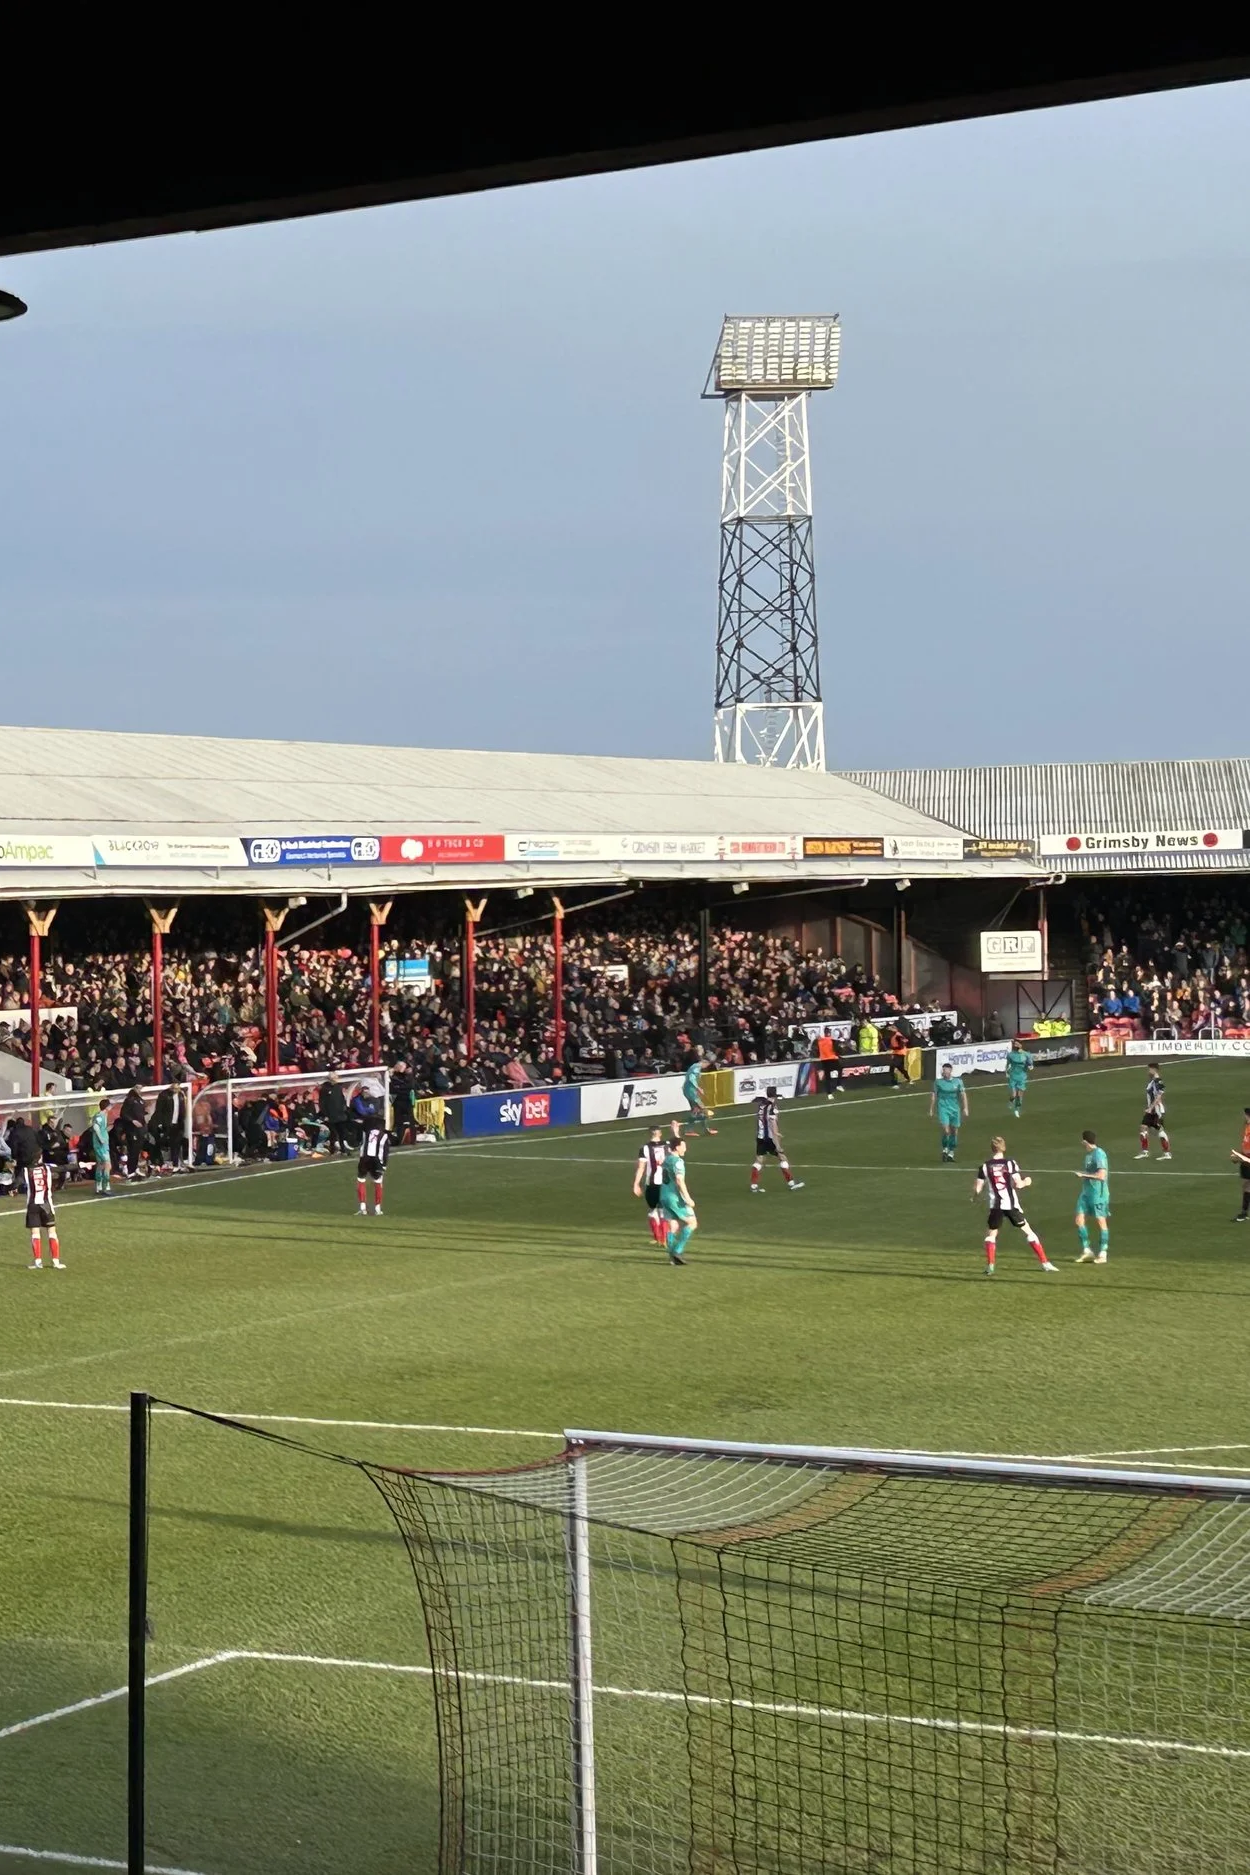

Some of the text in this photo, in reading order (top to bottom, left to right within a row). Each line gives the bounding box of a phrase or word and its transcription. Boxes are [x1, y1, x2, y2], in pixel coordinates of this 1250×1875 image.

[1085, 834, 1199, 849] Grimsby News
[500, 1097, 548, 1126] sky bet
